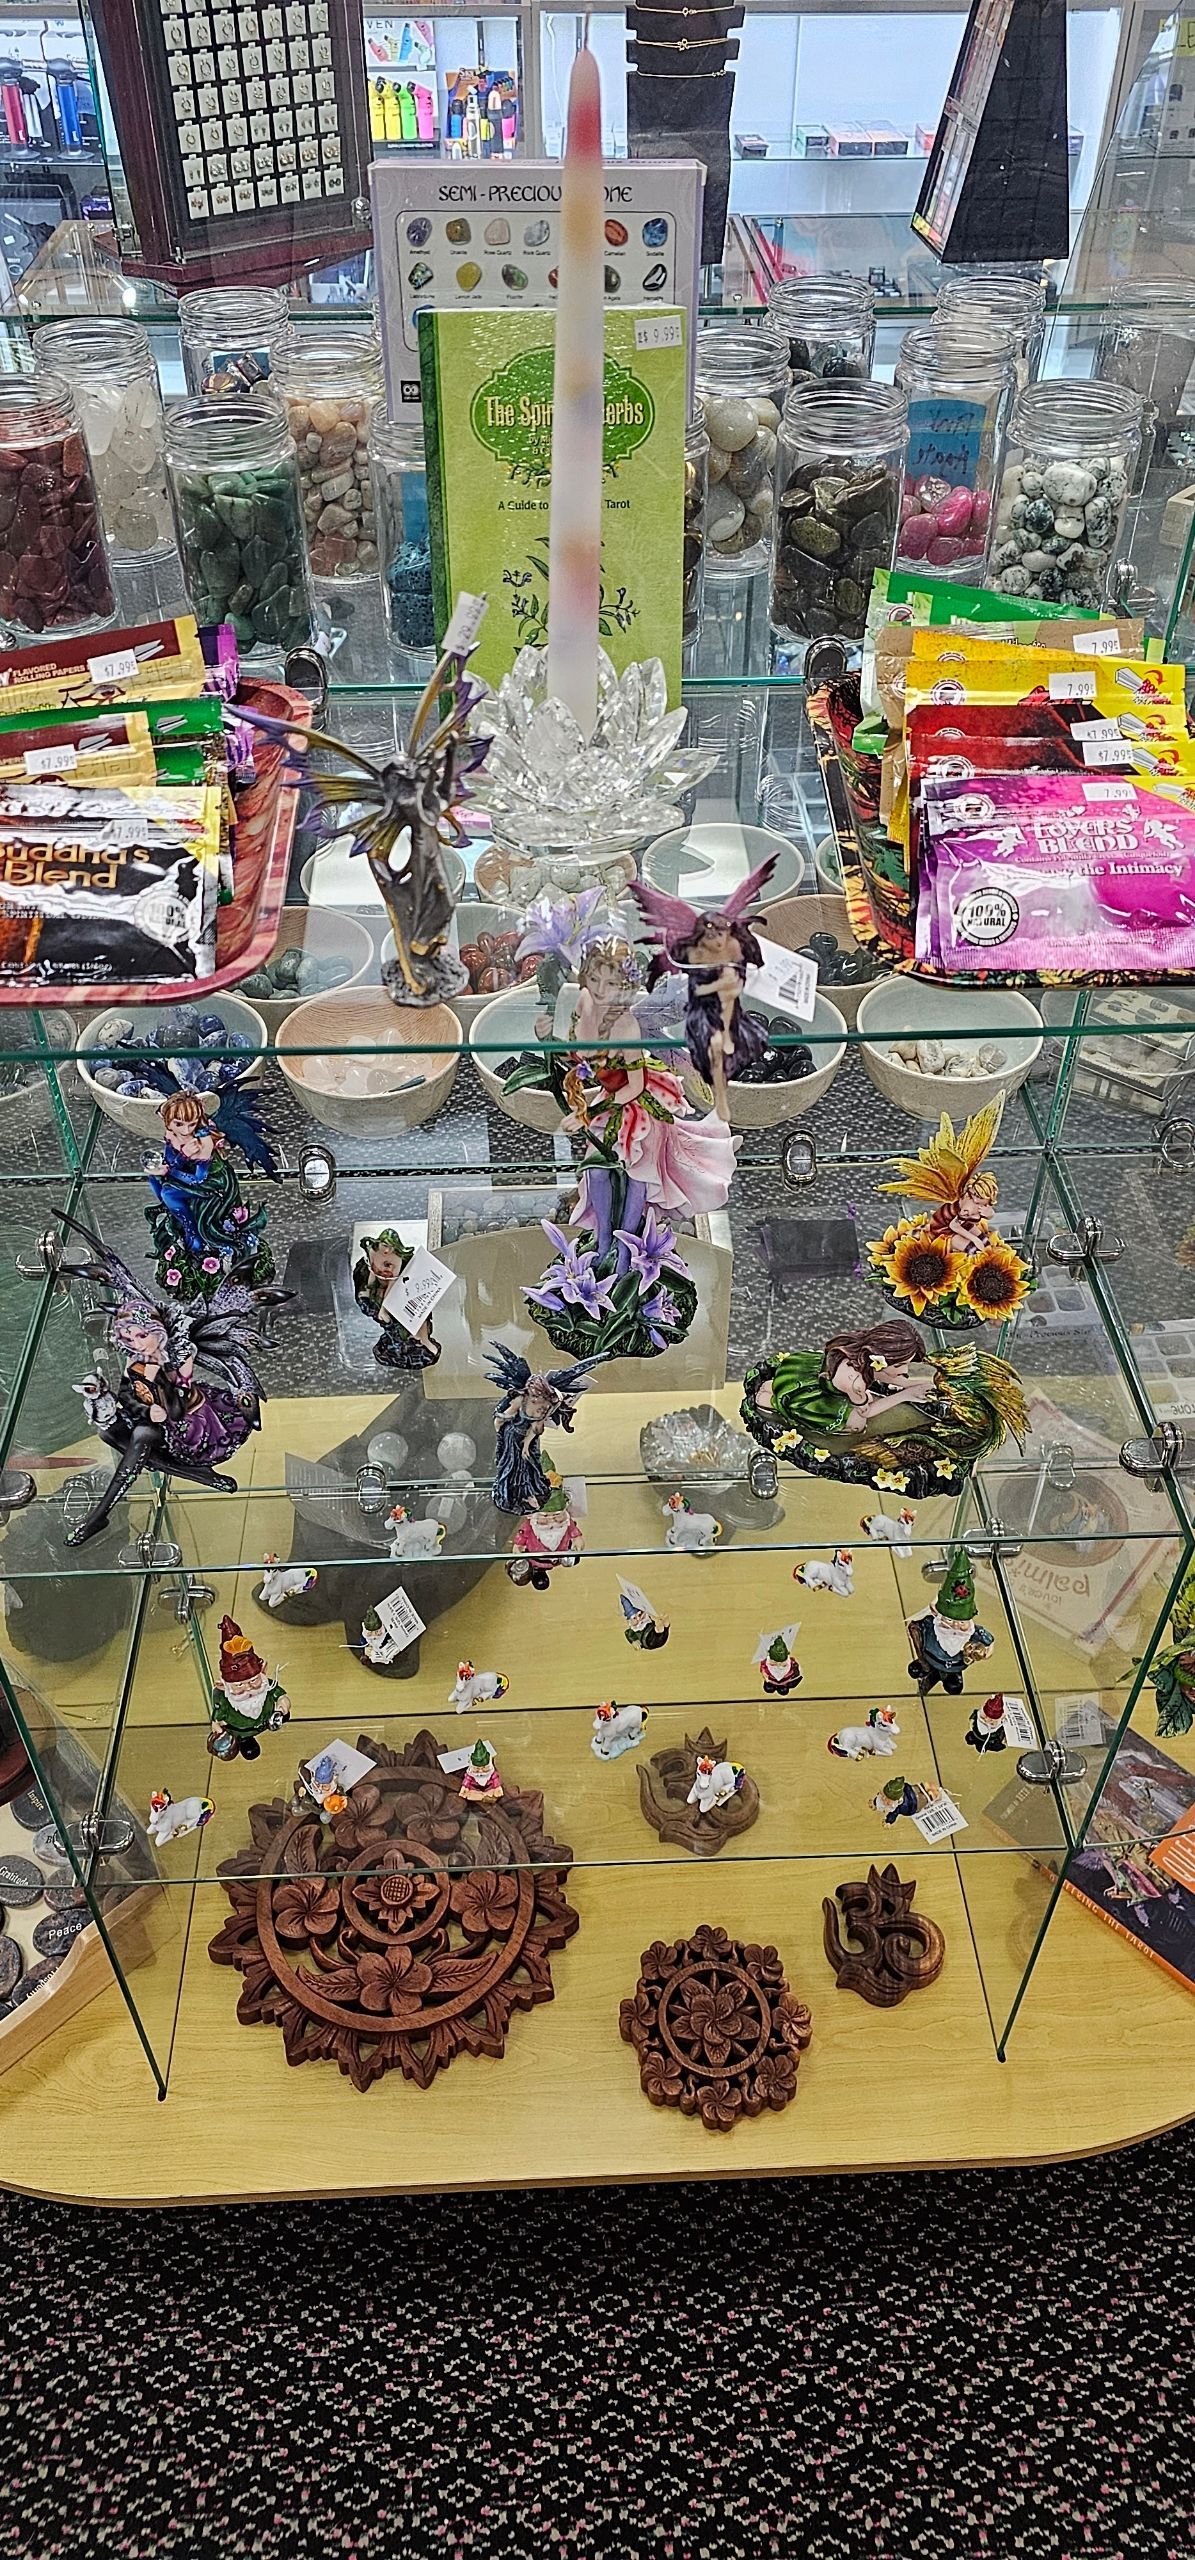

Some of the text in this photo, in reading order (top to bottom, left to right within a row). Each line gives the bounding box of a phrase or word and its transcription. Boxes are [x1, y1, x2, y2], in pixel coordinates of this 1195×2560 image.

[438, 185, 477, 202] SEMI
[488, 185, 562, 202] PRECIOU
[483, 395, 515, 427] The
[498, 500, 505, 510] A
[538, 501, 549, 510] to
[604, 499, 631, 510] Tarot
[12, 662, 57, 677] FLAVORED
[14, 670, 52, 684] ROLLING
[52, 664, 86, 677] PAPERS
[1034, 818, 1135, 840] LOVERS
[0, 841, 150, 866] uddha's
[1037, 833, 1139, 854] BLEND
[3, 861, 119, 889] Blend
[1109, 861, 1183, 877] Intimacy
[27, 1789, 45, 1811] Inspire
[48, 1922, 83, 1940] Peace
[1124, 1931, 1156, 1960] TAROT
